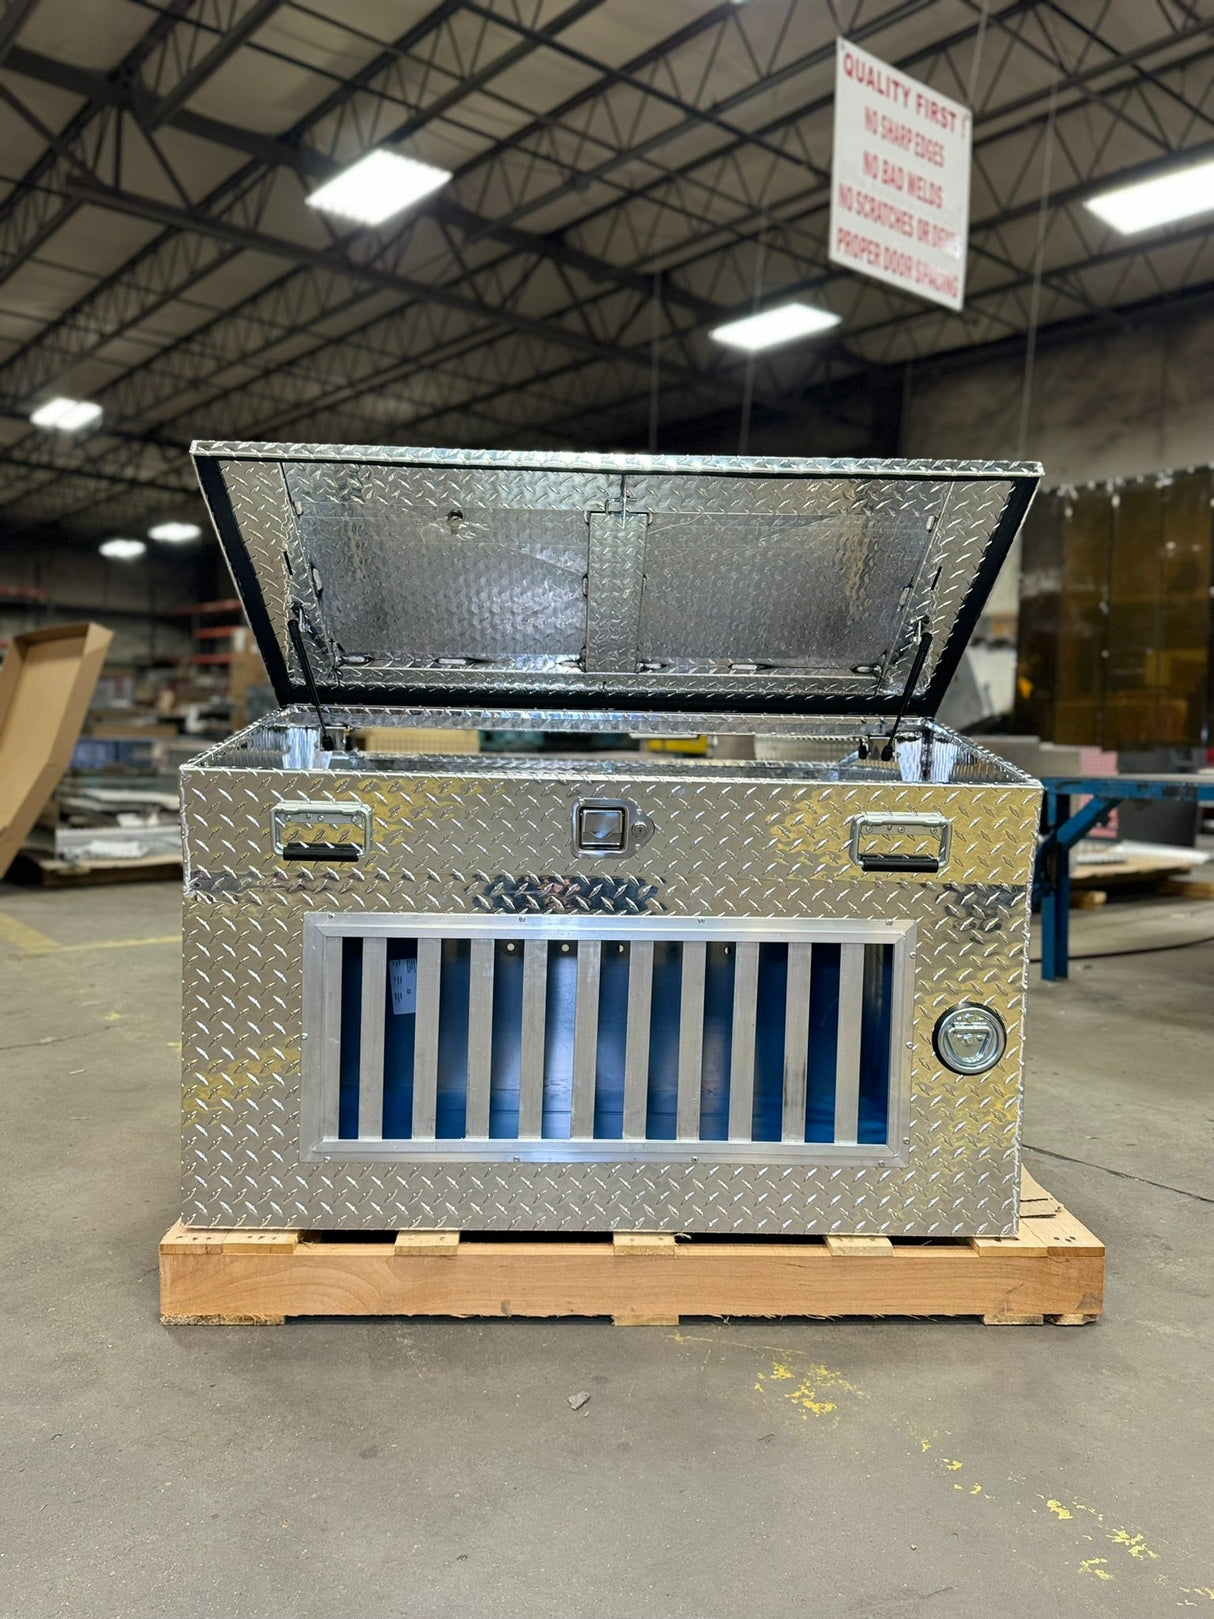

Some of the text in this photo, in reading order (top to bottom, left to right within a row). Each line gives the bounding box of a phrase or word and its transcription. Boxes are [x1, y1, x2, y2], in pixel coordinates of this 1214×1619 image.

[843, 52, 911, 109] QUALITY
[915, 93, 957, 133] FIRST
[865, 106, 945, 168] NO SHARP EDGES
[863, 150, 944, 209] NO BAD WELDS
[838, 182, 854, 212] NO
[856, 190, 914, 237] SCRATCHES
[917, 217, 930, 244] OR
[837, 227, 881, 267] PROPER
[883, 245, 914, 280] DOOR
